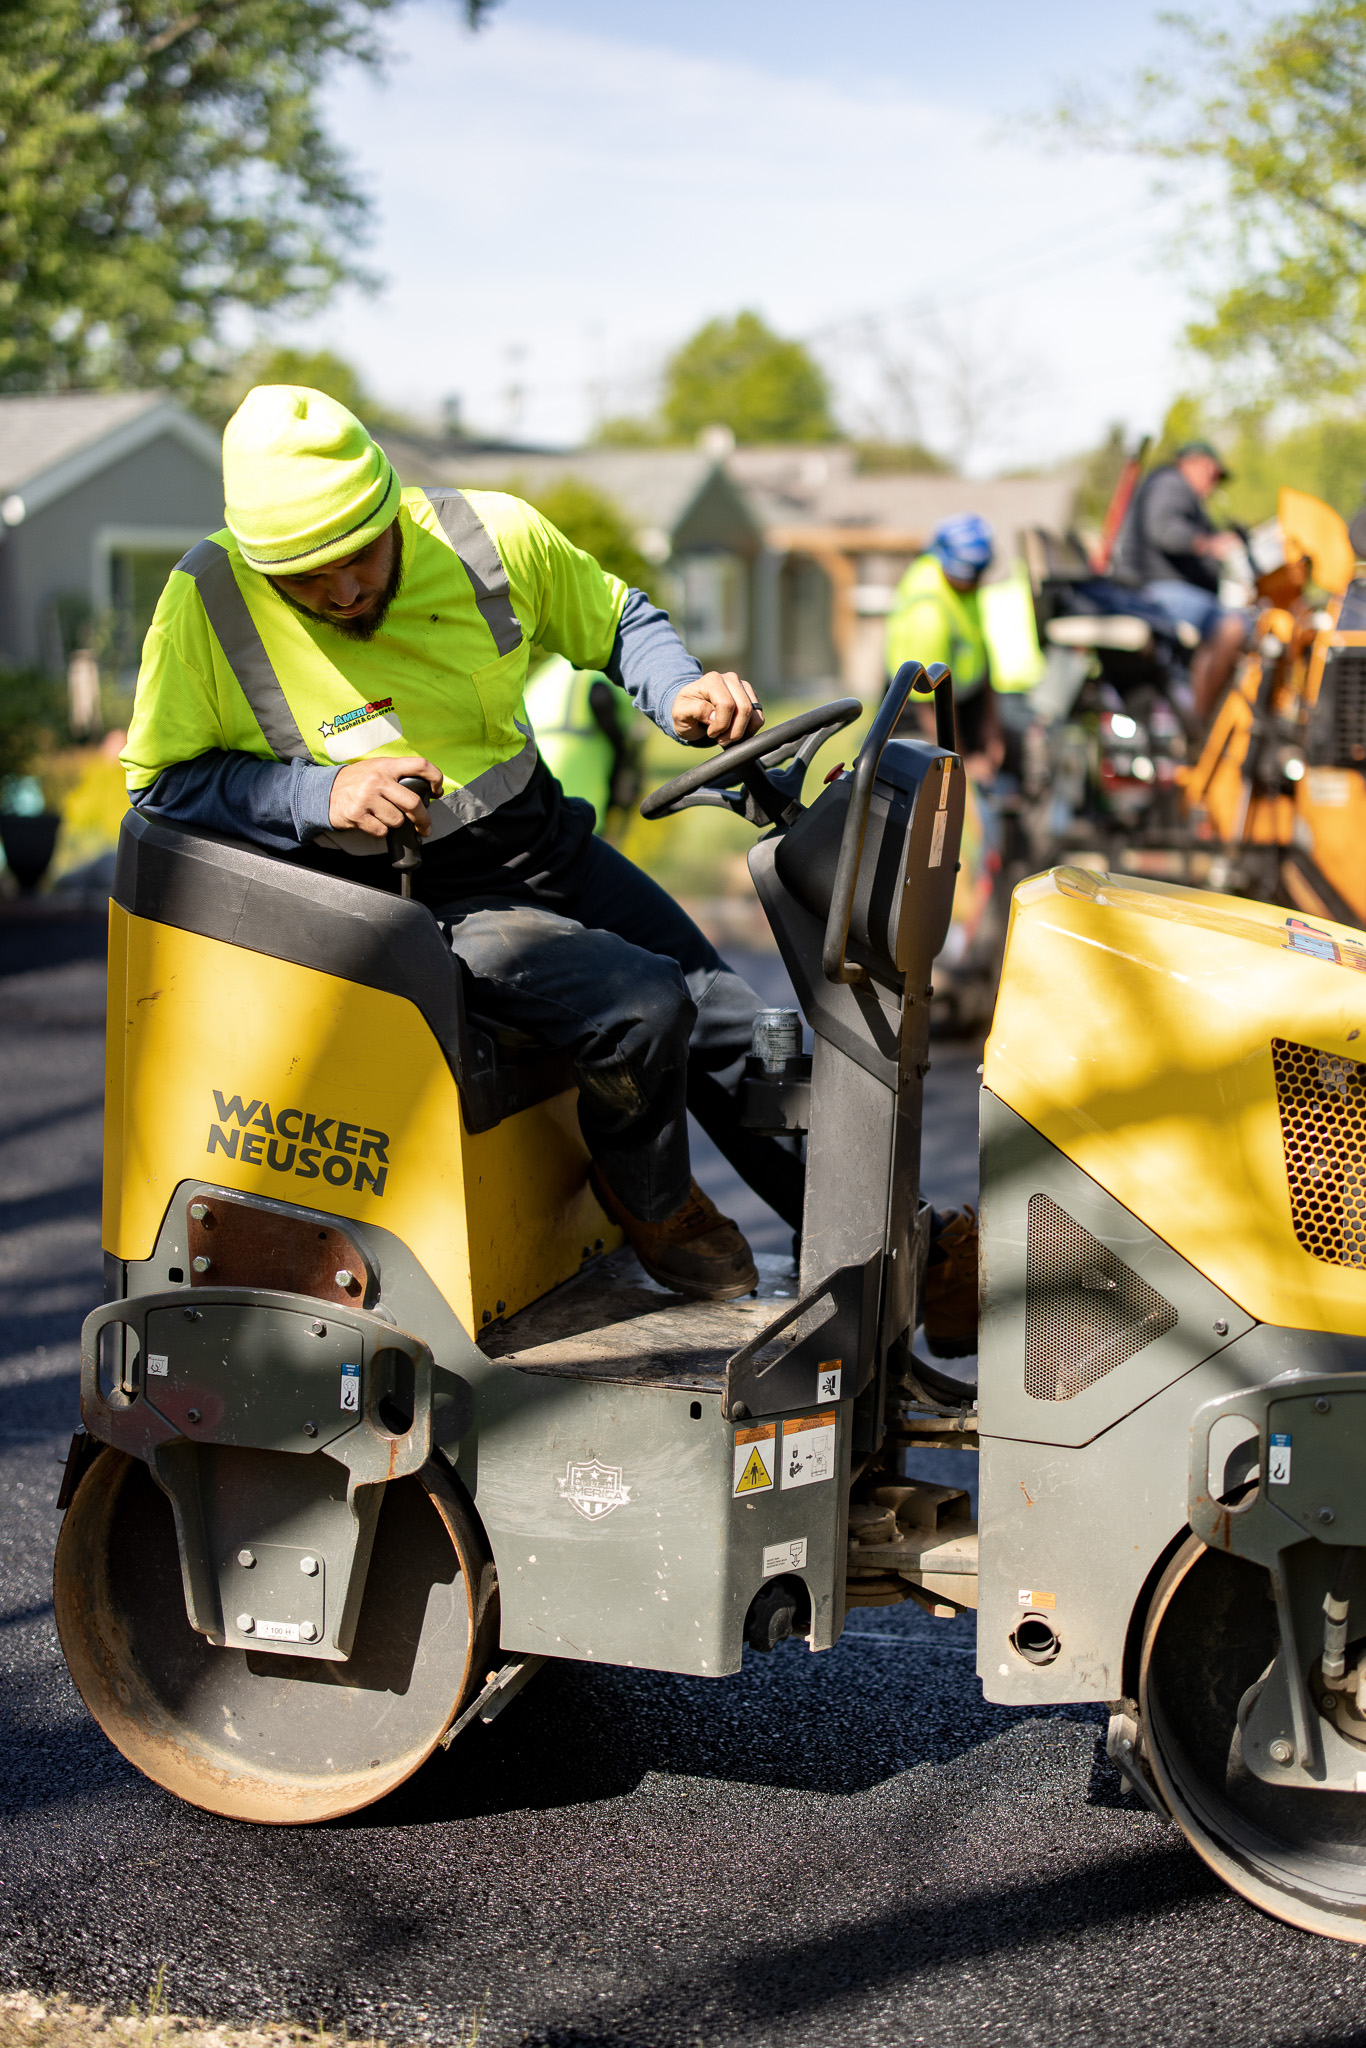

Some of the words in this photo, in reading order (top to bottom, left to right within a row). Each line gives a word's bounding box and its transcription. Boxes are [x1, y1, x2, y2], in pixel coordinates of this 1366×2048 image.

[337, 718, 361, 733] Asphalt
[366, 706, 395, 721] Concrete
[212, 1089, 390, 1165] WACKER
[206, 1123, 389, 1198] NEUSON
[569, 1486, 623, 1501] MERICA
